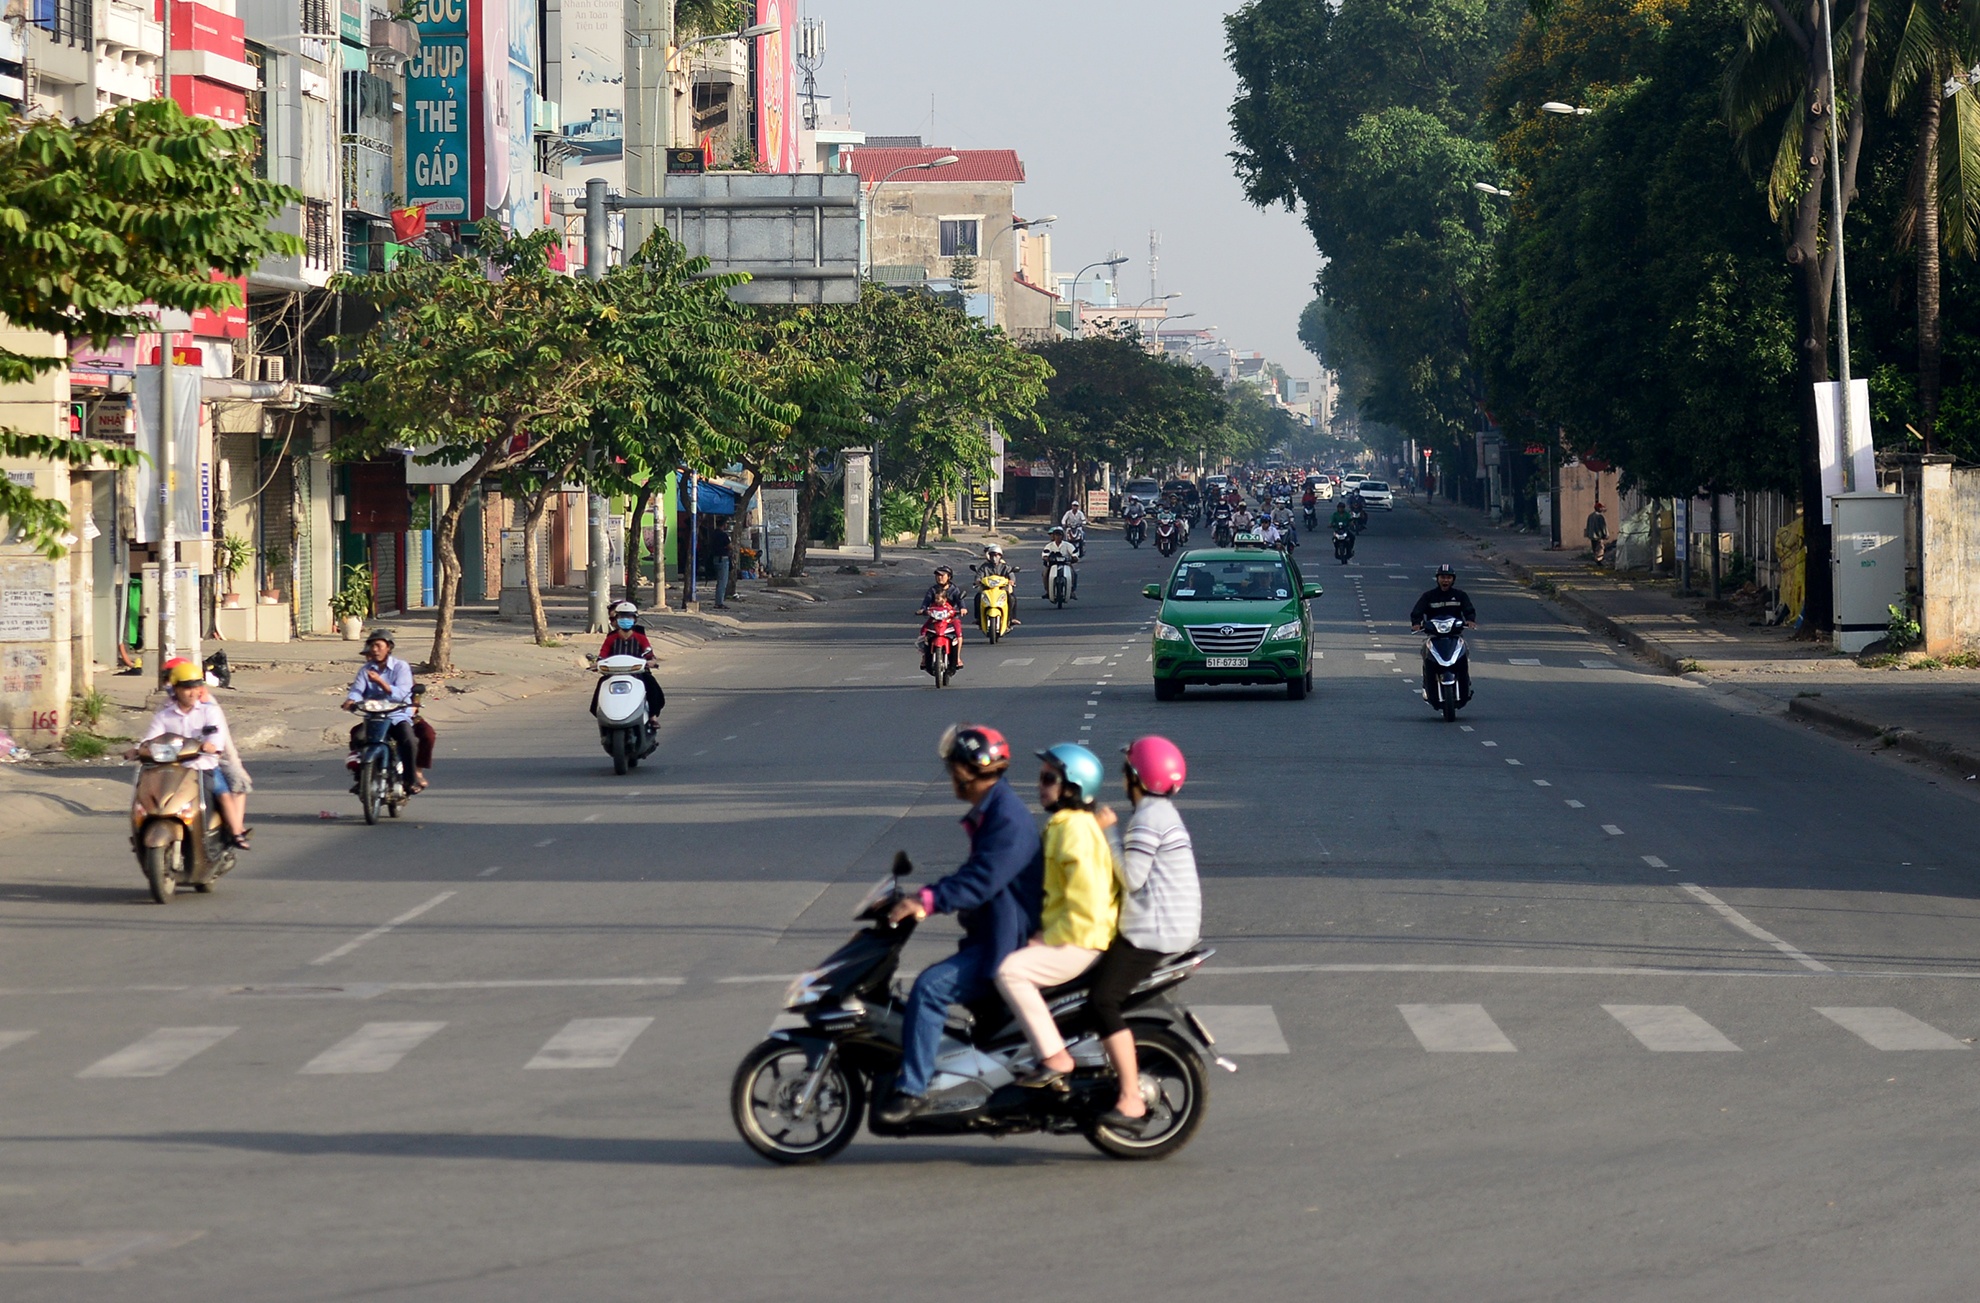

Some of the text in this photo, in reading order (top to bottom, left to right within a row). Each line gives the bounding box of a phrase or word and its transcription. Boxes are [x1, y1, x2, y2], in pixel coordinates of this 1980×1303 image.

[575, 11, 586, 19] An
[409, 45, 464, 88] CHỤP
[415, 88, 457, 132] THẺ
[415, 139, 458, 186] GẤP
